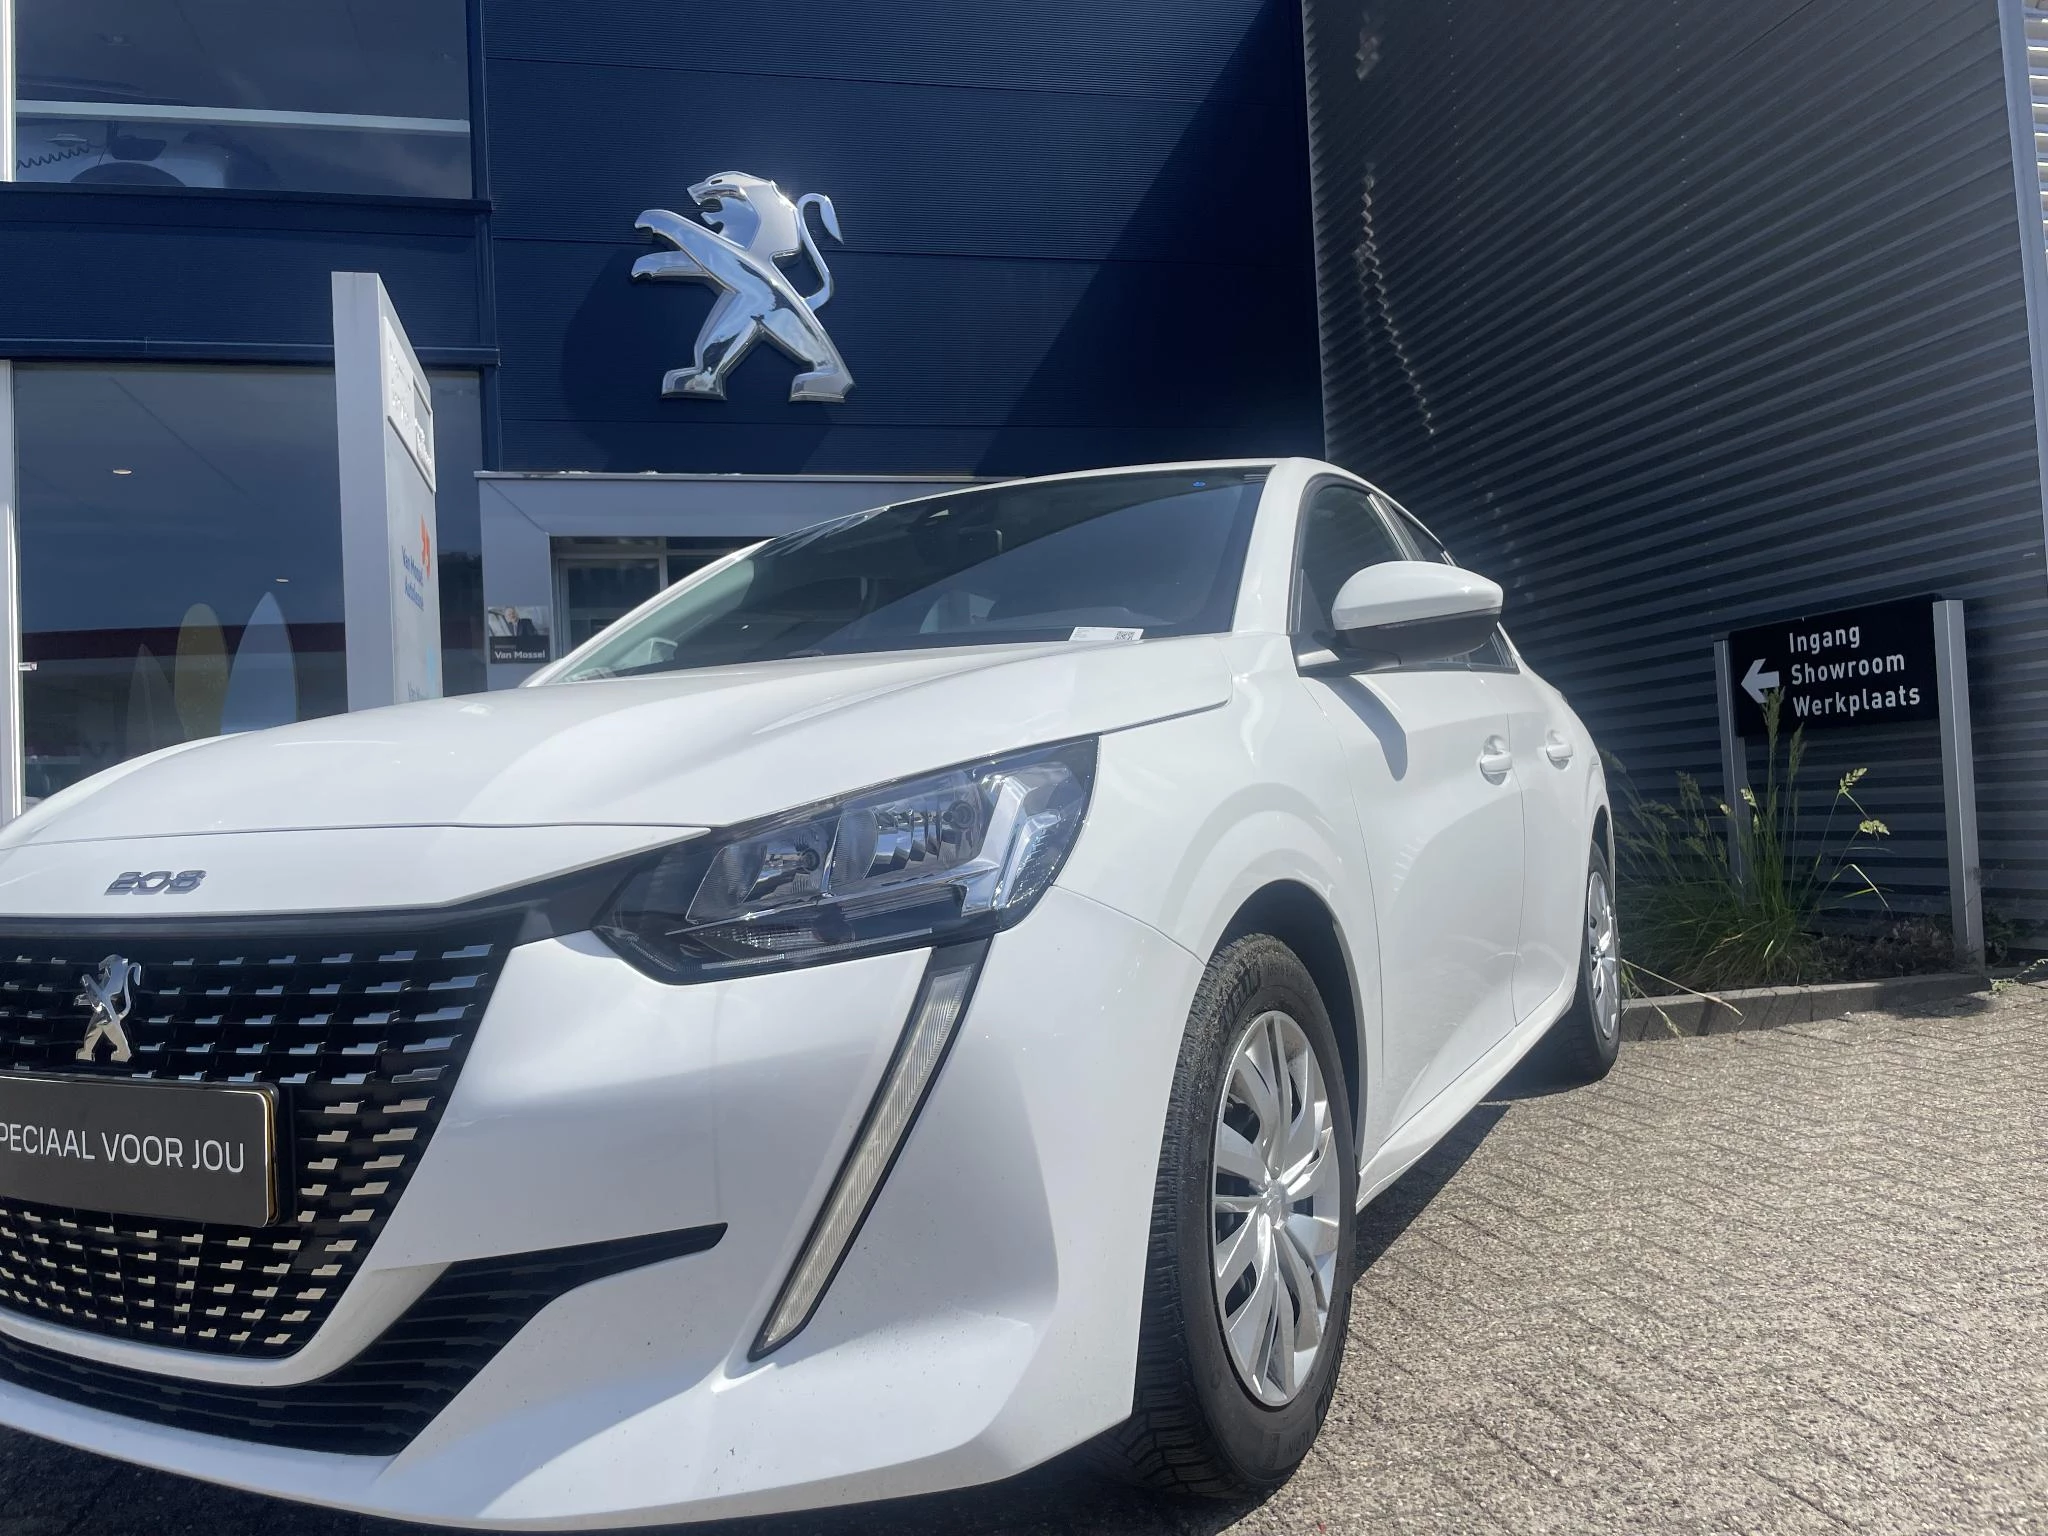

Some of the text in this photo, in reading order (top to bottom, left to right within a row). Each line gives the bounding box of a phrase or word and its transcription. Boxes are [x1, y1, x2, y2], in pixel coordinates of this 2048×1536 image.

[494, 650, 545, 659] Van Mossel
[1789, 626, 1860, 654] Ingang
[1791, 653, 1905, 685] Showroom
[1793, 685, 1920, 717] Werkplaats
[104, 869, 207, 895] 208
[101, 1132, 183, 1168] VOOR
[192, 1140, 245, 1173] JOU
